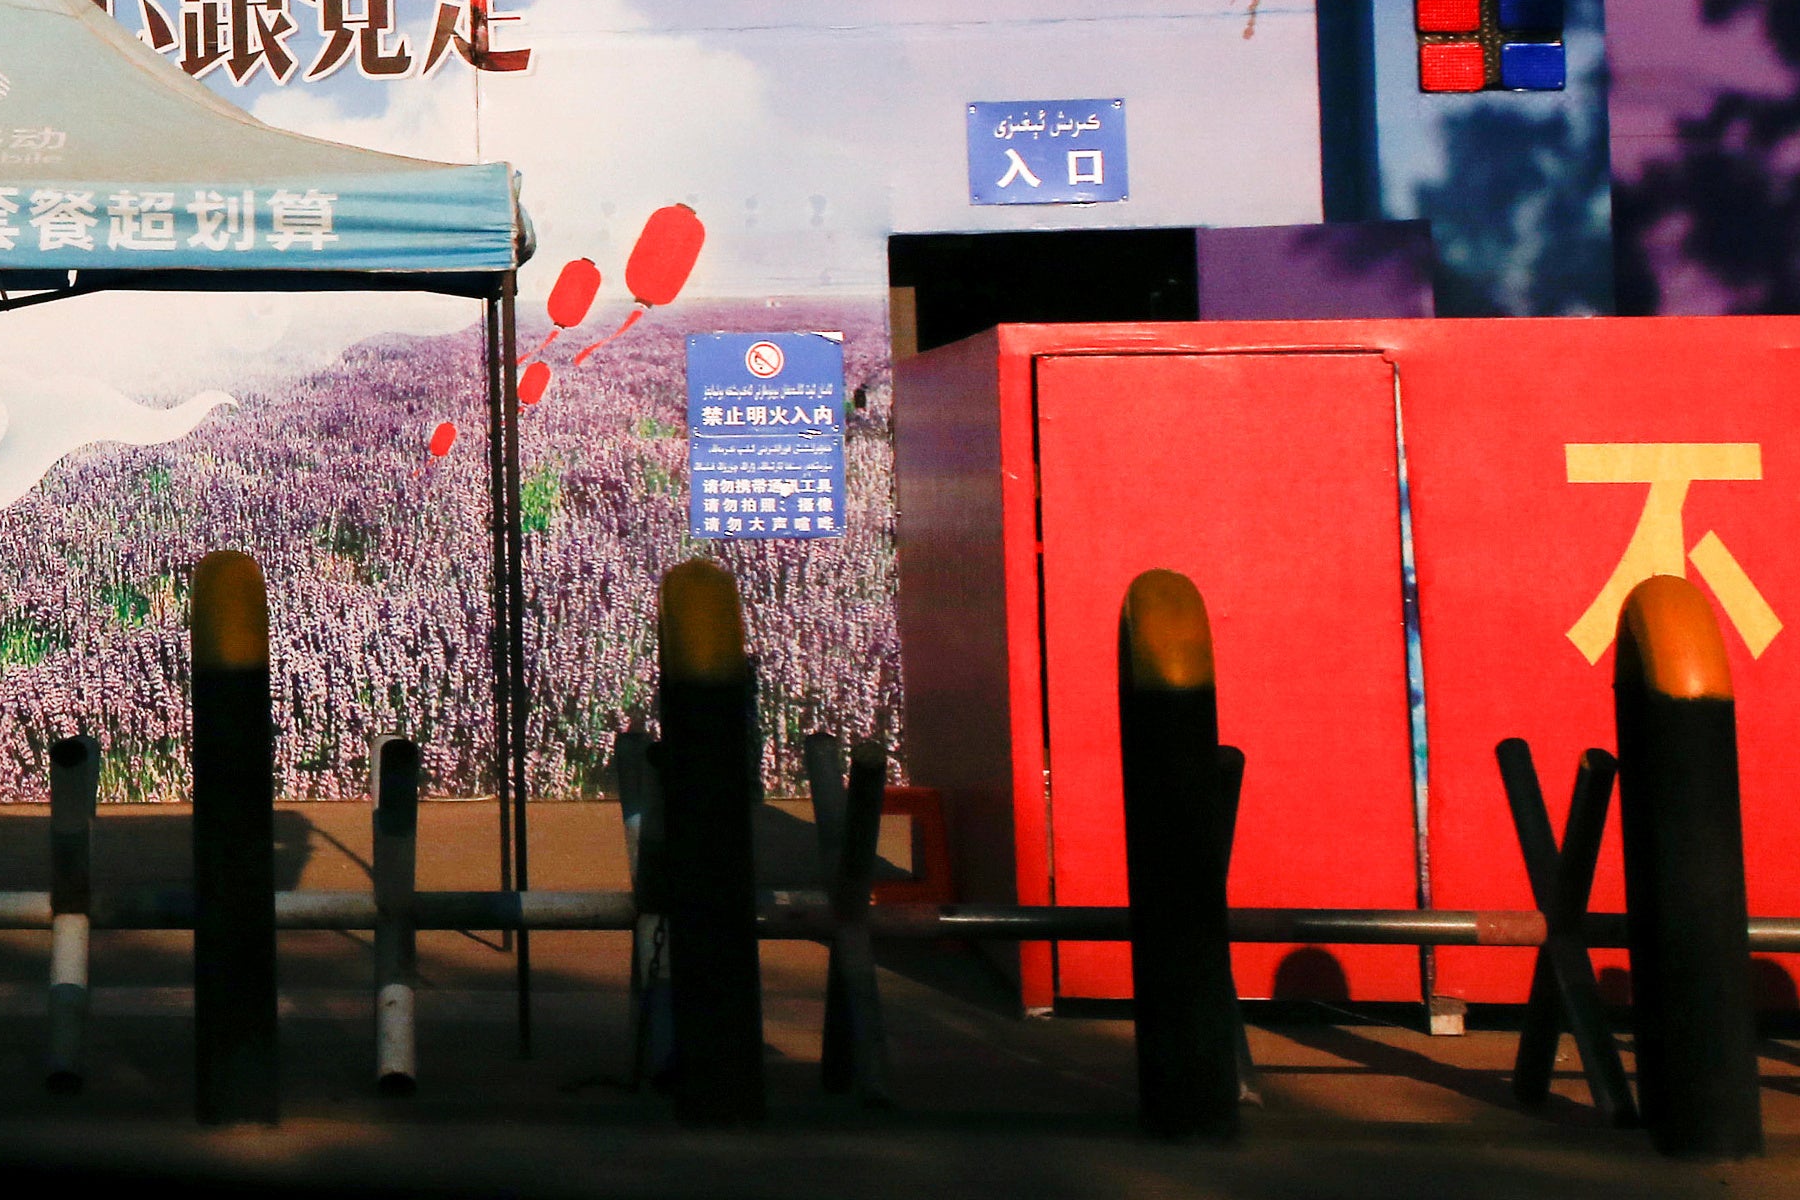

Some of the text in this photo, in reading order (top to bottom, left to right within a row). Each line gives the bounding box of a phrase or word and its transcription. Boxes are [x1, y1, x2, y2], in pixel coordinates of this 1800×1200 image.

[996, 148, 1105, 188] 入口
[701, 405, 834, 426] 禁止明火入内
[1565, 443, 1783, 667] 不
